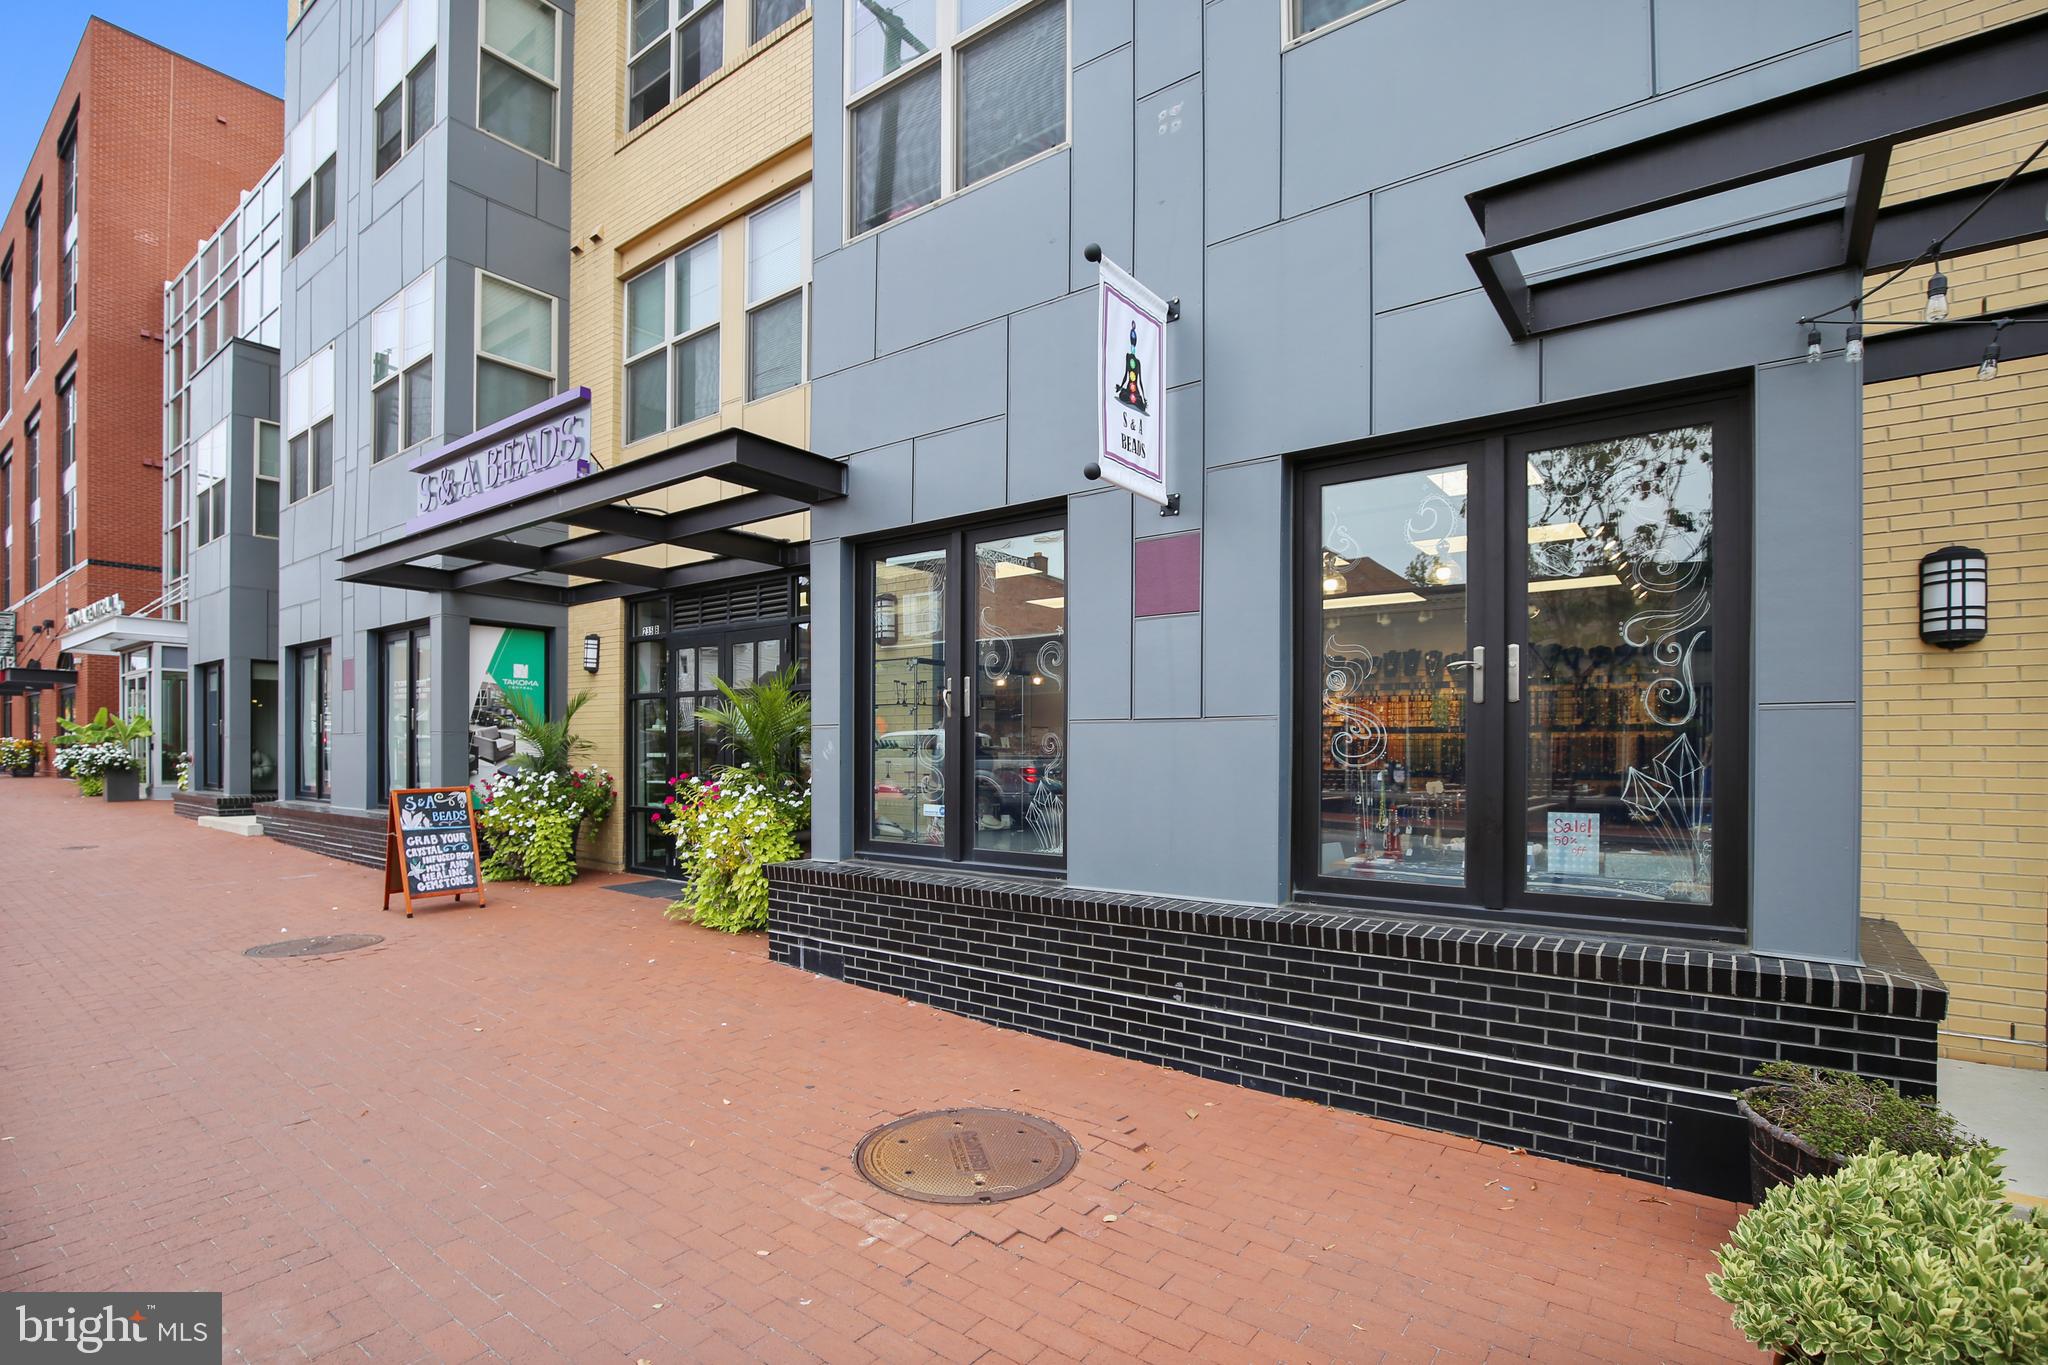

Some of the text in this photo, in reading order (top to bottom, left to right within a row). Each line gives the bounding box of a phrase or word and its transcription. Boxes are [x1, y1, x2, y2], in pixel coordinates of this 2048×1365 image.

[486, 415, 584, 489] BEADS
[1121, 432, 1146, 459] BEADS
[502, 678, 540, 687] TAKOMA
[432, 810, 467, 822] BEADS
[1553, 818, 1592, 838] Sale!
[406, 832, 468, 846] GRAB YOUR
[1553, 835, 1578, 846] 50%
[406, 845, 444, 858] CRYSTAL
[422, 851, 474, 864] INFUSED BODY
[1571, 846, 1588, 857] off
[425, 860, 469, 873] MIST AND
[422, 868, 467, 882] HEALING
[417, 875, 474, 891] GEMSTONES
